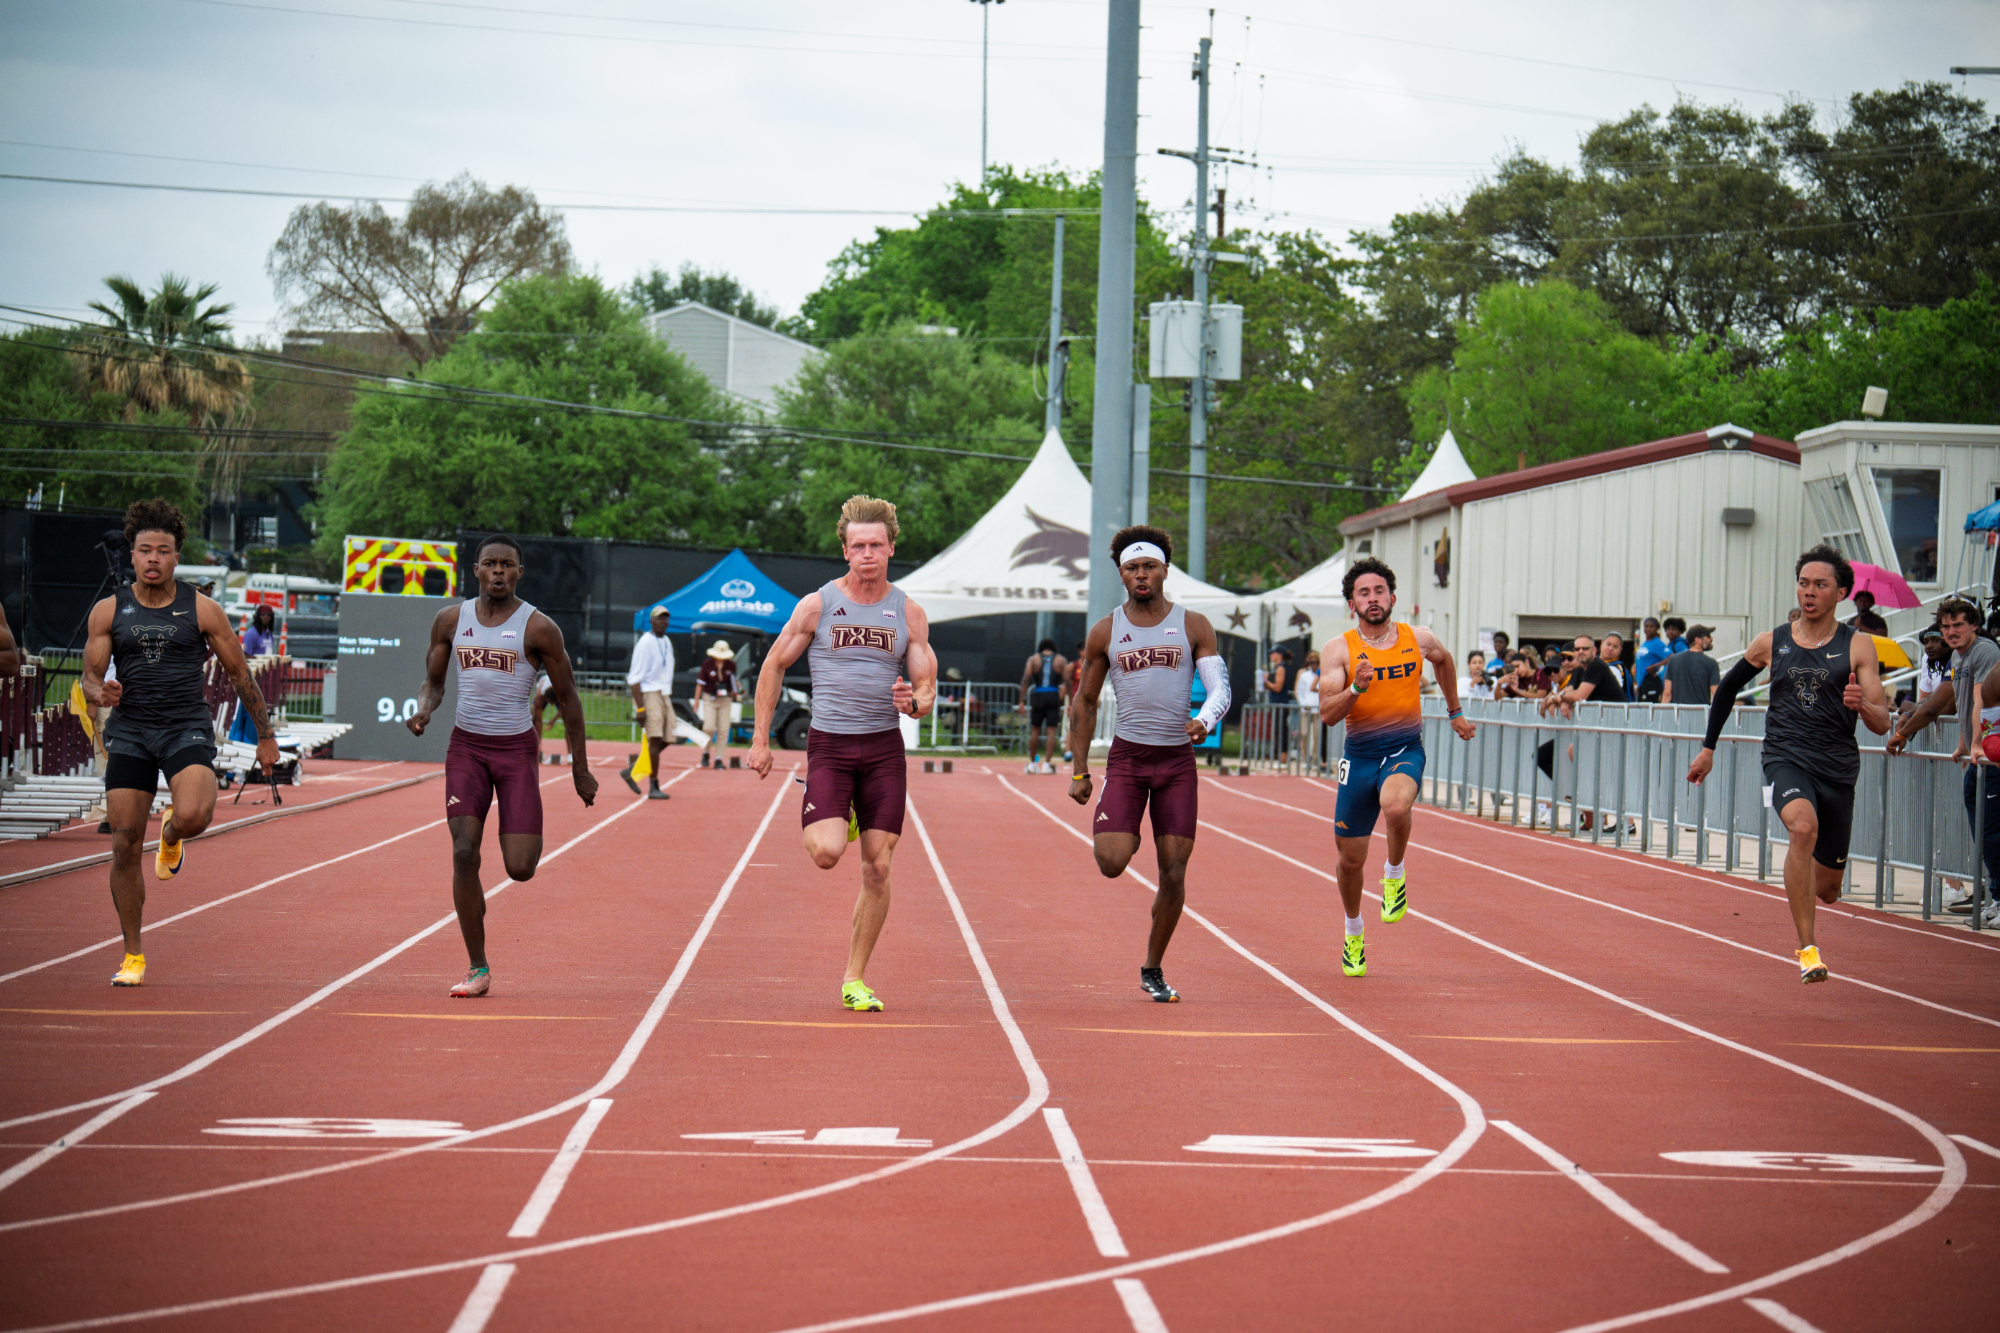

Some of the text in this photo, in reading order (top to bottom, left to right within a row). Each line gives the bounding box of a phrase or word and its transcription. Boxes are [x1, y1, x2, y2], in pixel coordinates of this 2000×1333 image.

[962, 587, 1070, 600] TEXAS
[699, 599, 775, 613] Allstate
[829, 624, 898, 656] TXST
[456, 645, 519, 676] TXST
[1116, 645, 1184, 676] TXST
[1368, 661, 1417, 682] TEP
[1338, 760, 1348, 783] 6
